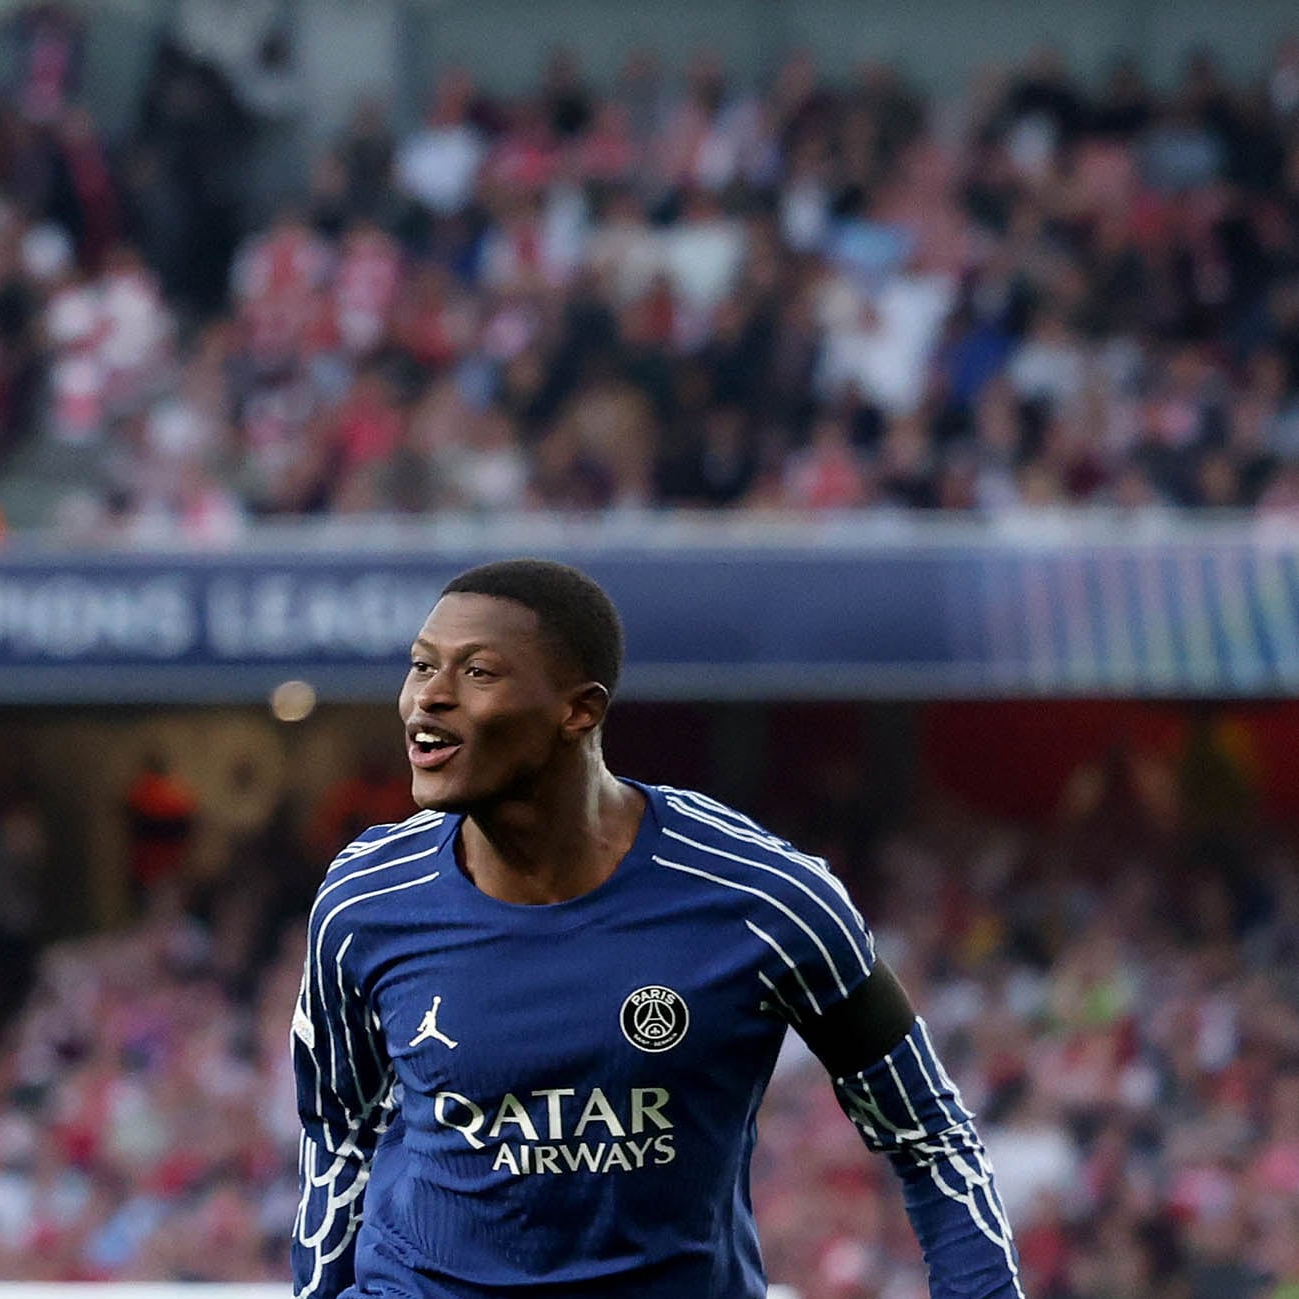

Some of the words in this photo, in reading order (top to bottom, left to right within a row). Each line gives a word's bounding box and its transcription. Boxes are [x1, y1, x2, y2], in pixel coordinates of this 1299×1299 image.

[631, 989, 676, 1006] PARIS
[434, 1087, 674, 1149] QATAR
[492, 1134, 676, 1175] AIRWAYS
